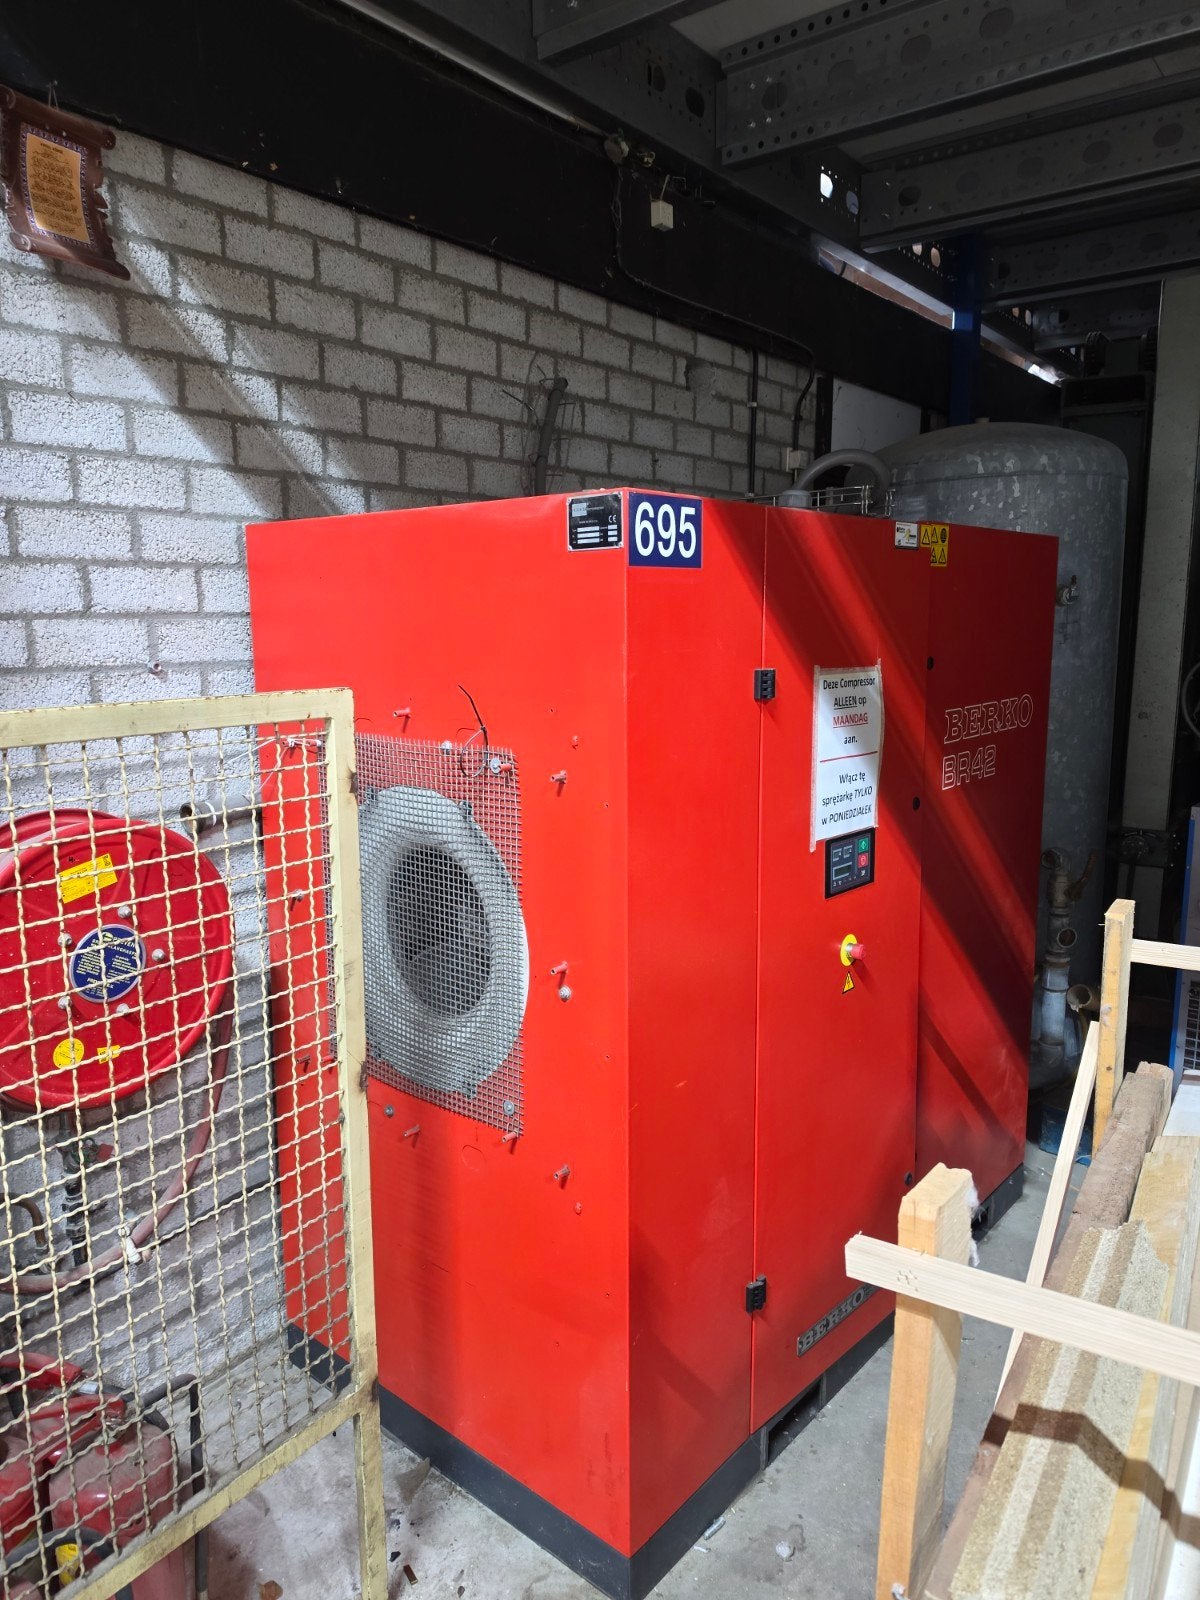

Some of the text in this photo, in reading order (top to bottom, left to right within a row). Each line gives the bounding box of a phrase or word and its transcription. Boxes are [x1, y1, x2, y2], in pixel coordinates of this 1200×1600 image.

[634, 501, 697, 559] 695
[823, 677, 876, 690] Deze Compressor
[833, 695, 867, 708] ALLEEN op
[833, 712, 868, 726] MAANDAG
[943, 693, 1034, 745] BERKO
[843, 735, 858, 745] aan.
[941, 744, 997, 791] BR42
[839, 771, 866, 785] Włącz tę
[854, 785, 873, 799] TYLKO
[821, 804, 873, 826] w PONIEDZIAŁEK
[799, 1288, 865, 1355] BERKO
